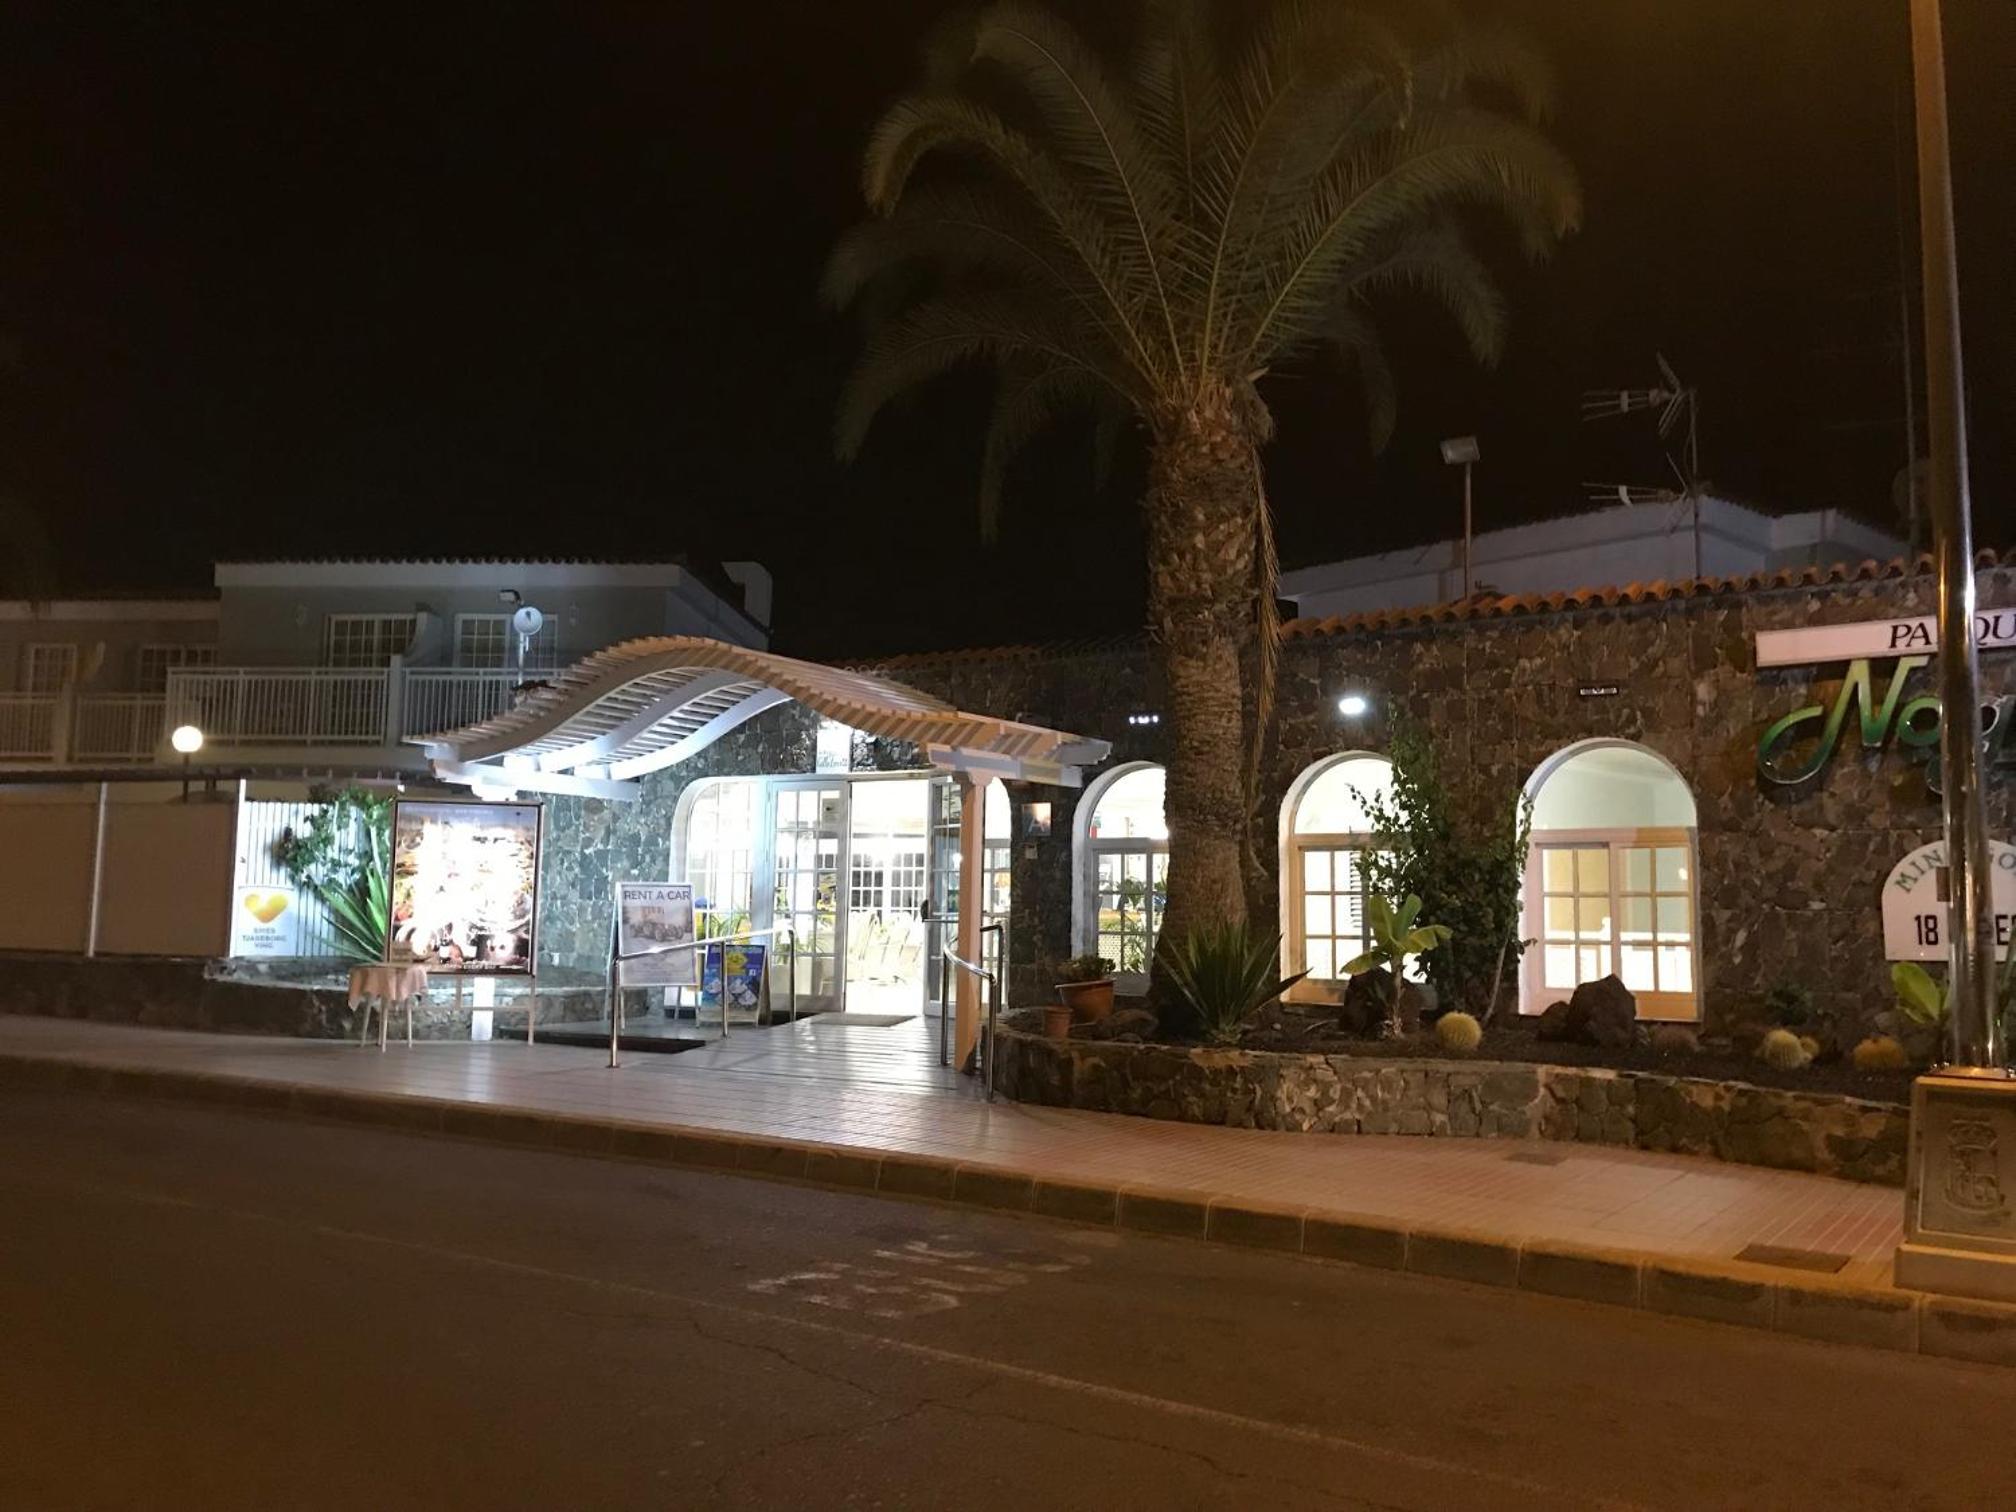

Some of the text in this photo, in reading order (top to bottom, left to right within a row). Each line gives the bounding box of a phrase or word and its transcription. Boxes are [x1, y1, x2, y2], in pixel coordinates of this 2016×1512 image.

[623, 890, 690, 900] RENT A CAR
[1914, 914, 1939, 946] 18
